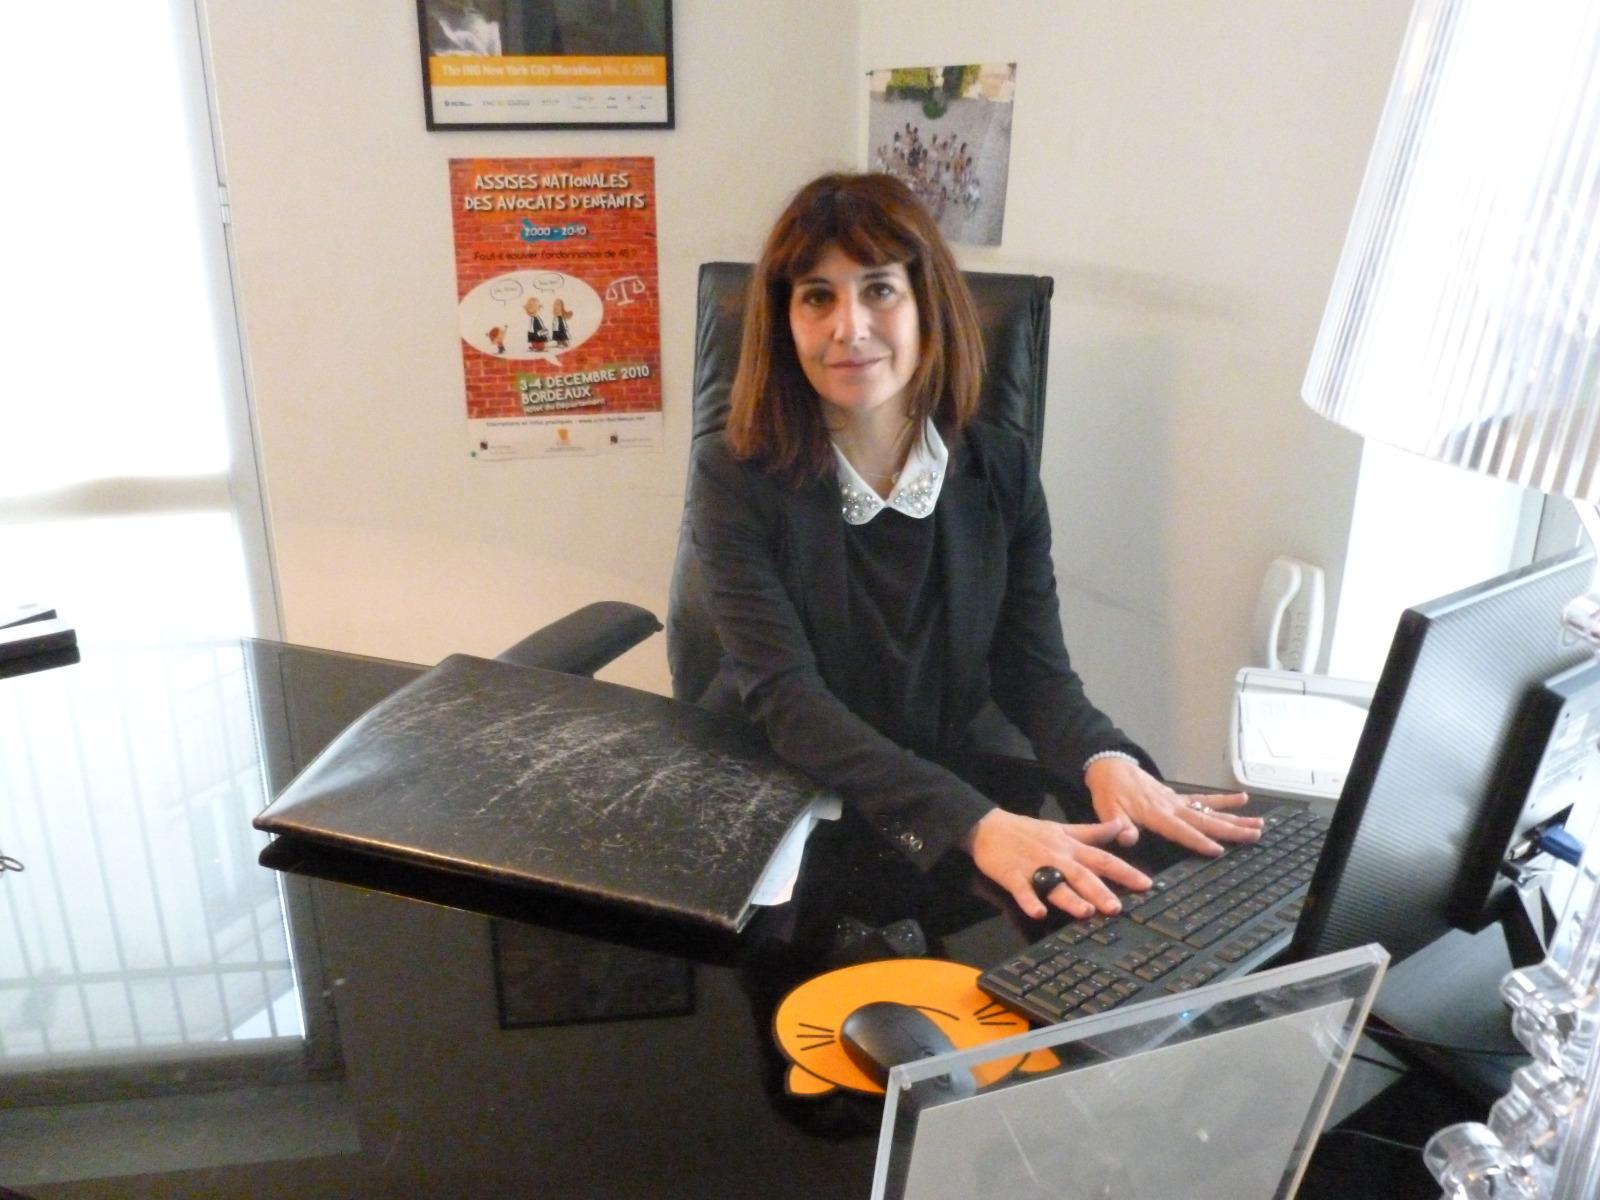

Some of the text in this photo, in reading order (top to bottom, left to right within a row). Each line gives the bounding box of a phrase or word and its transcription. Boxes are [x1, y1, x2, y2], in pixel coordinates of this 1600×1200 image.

[442, 64, 461, 76] The
[482, 64, 504, 76] New
[505, 64, 529, 76] York
[530, 64, 551, 78] City
[552, 64, 601, 76] Marathon
[475, 173, 629, 190] ASSISES NATIONALES
[464, 193, 646, 211] DES AVOCATS D'ENFANTS
[524, 226, 551, 237] 2000
[561, 226, 588, 236] 2010
[519, 378, 543, 391] 3-4
[620, 365, 650, 380] 2010
[520, 386, 592, 405] BORDEAUX
